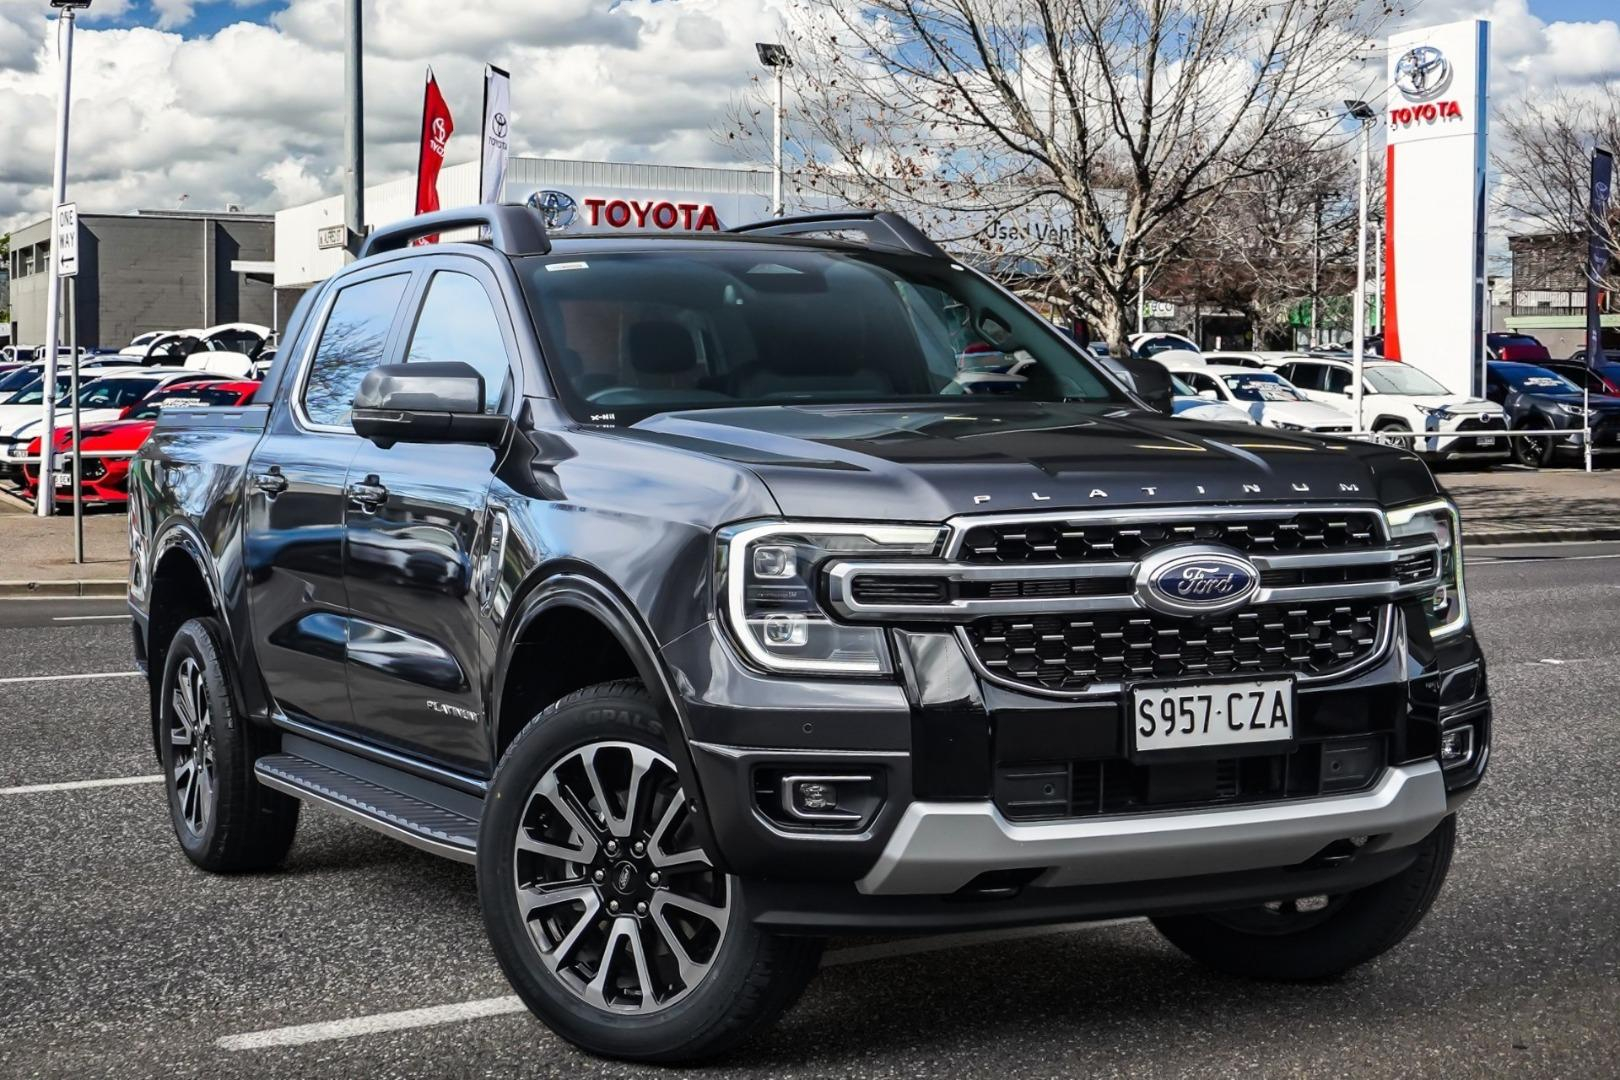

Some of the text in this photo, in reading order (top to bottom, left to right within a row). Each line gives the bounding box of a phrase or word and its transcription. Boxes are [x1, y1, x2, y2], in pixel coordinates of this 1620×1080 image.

[1389, 101, 1462, 125] TOYOTA
[60, 210, 73, 228] ONE
[585, 199, 721, 231] TOYOTA
[60, 232, 75, 248] WAY
[974, 482, 1360, 505] PLATINUM
[1178, 566, 1235, 596] Ford
[426, 700, 479, 723] PLATINUM
